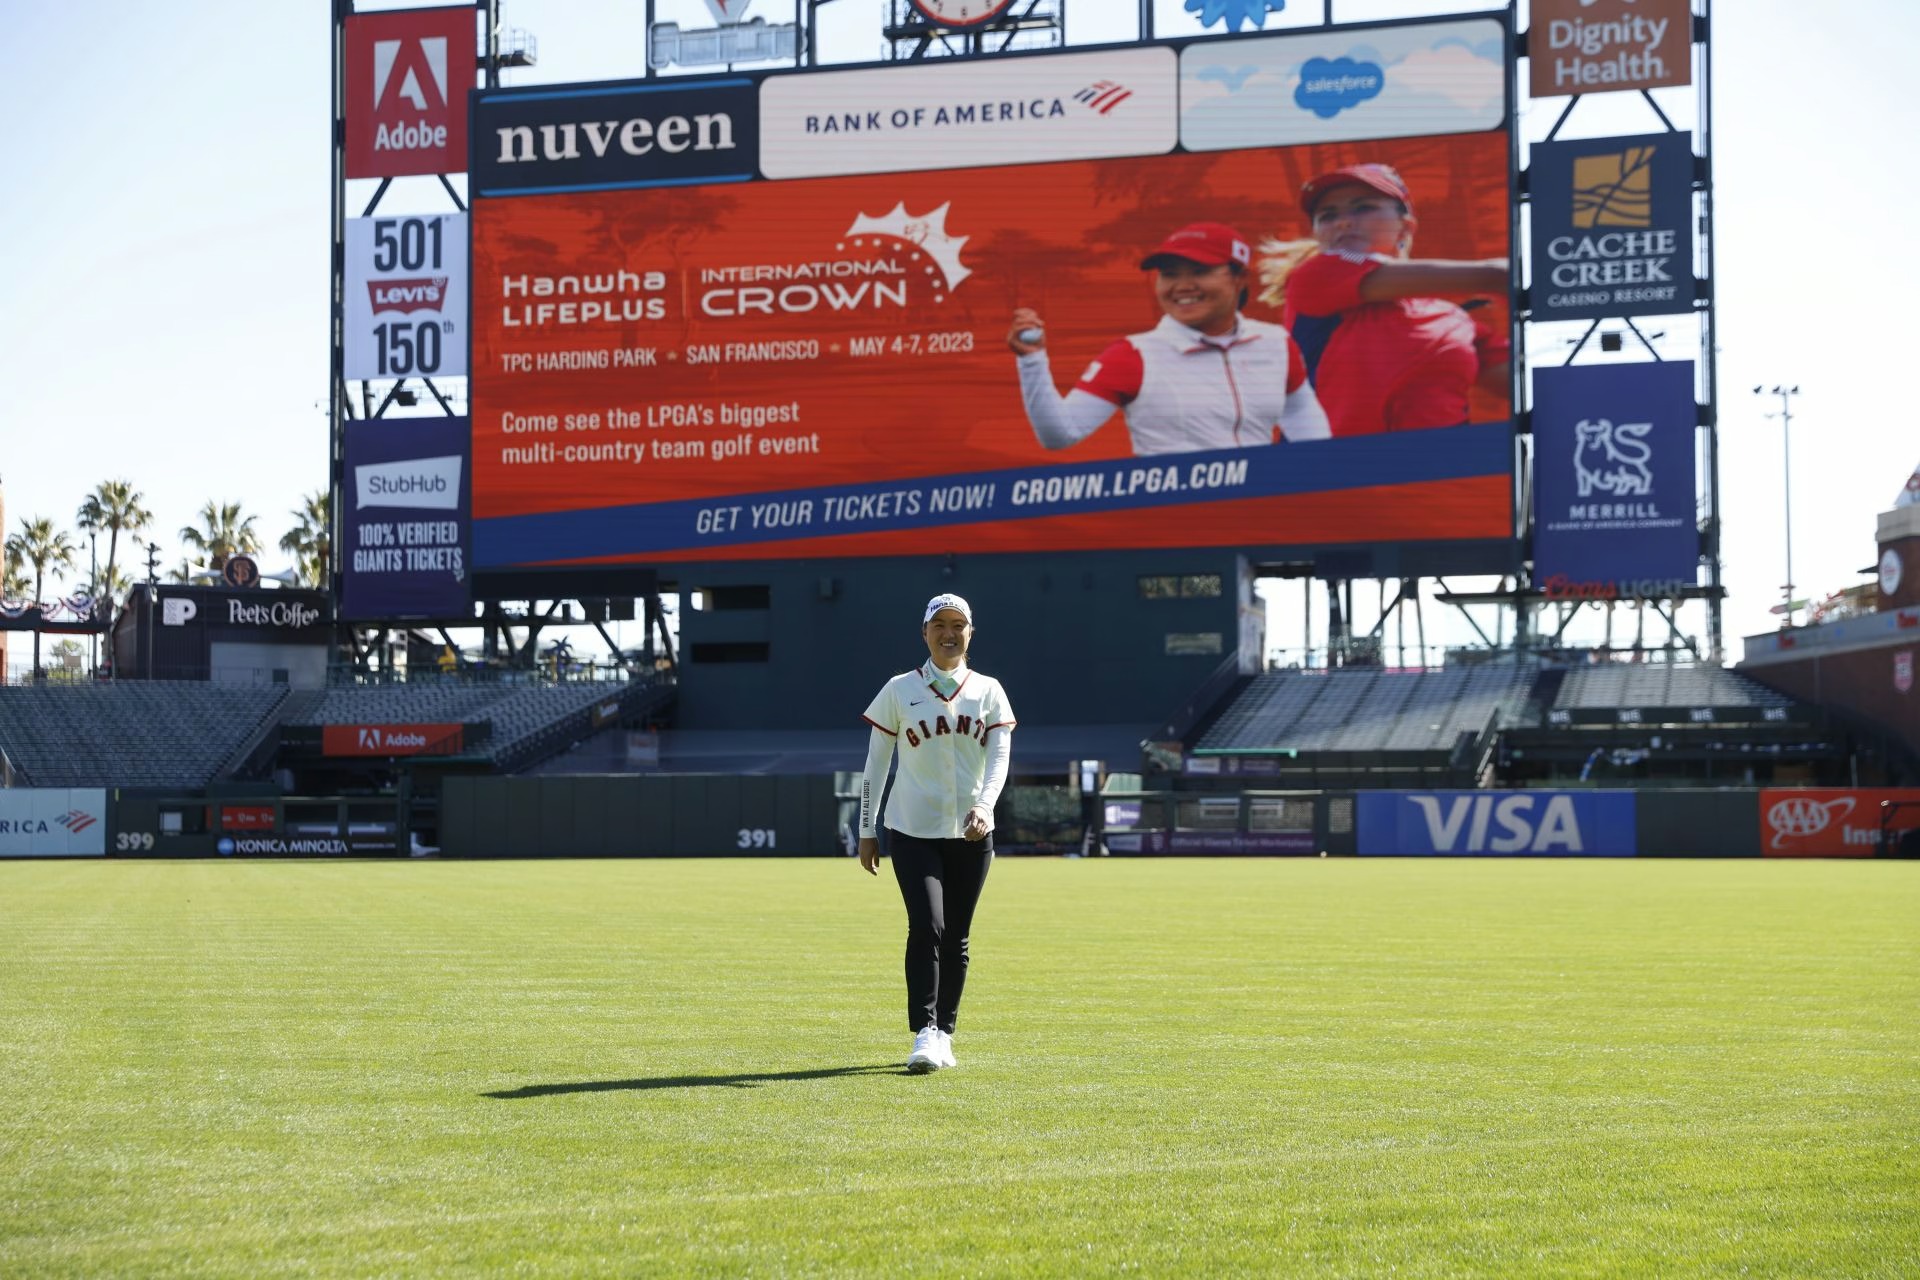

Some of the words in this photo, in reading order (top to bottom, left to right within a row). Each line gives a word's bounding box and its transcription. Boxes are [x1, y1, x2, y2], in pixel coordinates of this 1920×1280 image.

[1548, 17, 1668, 56] Dignity
[1555, 49, 1665, 87] Health
[1305, 74, 1377, 94] salesforce
[806, 111, 881, 134] BANK
[891, 108, 925, 129] OF
[935, 98, 1065, 126] AMERICA
[375, 119, 447, 152] Adobe
[496, 111, 736, 163] nuveen
[374, 217, 442, 272] 501
[1547, 230, 1676, 261] CACHE
[503, 269, 666, 298] Hanwha
[702, 258, 906, 284] INTERNATIONAL
[1551, 258, 1673, 289] CREEK
[702, 279, 907, 316] CROWN
[1547, 290, 1609, 307] CASINO
[1613, 286, 1676, 303] RESORT
[503, 298, 666, 327] LIFEPLUS
[501, 352, 532, 373] TPC
[537, 349, 609, 372] HARDING
[613, 347, 657, 368] PARK
[686, 343, 720, 365] SAN
[725, 340, 819, 363] FRANCISCO
[850, 336, 886, 357] MAY
[891, 335, 924, 356] 4-7,
[928, 332, 973, 353] 2023
[502, 410, 558, 434] Come
[564, 412, 600, 431] see
[607, 407, 641, 429] the
[648, 404, 714, 428] LPGA's
[720, 401, 800, 428] biggest
[502, 440, 645, 465] multi-country
[652, 438, 705, 459] team
[711, 434, 753, 461] golf
[758, 432, 820, 456] event
[368, 474, 447, 495] StubHub
[1011, 459, 1249, 506] CROWN.LPGA.COM
[697, 507, 742, 535] GET
[751, 500, 813, 529] YOUR
[824, 490, 922, 523] TICKETS
[929, 483, 996, 513] NOW!
[1569, 502, 1660, 520] MERRILL
[358, 523, 395, 546] 100%
[398, 521, 458, 545] VERIFIED
[354, 549, 402, 573] GIANTS
[405, 547, 463, 571] TICKETS
[1619, 578, 1684, 598] LIGHT
[227, 598, 270, 625] Peet's
[271, 601, 319, 629] Coffee
[385, 733, 426, 747] Adobe
[1405, 795, 1584, 852] VISA
[1773, 799, 1827, 835] AAA
[116, 832, 155, 850] 399
[236, 839, 287, 854] KONICA
[289, 839, 349, 854] MINOLTA
[737, 829, 777, 849] 391
